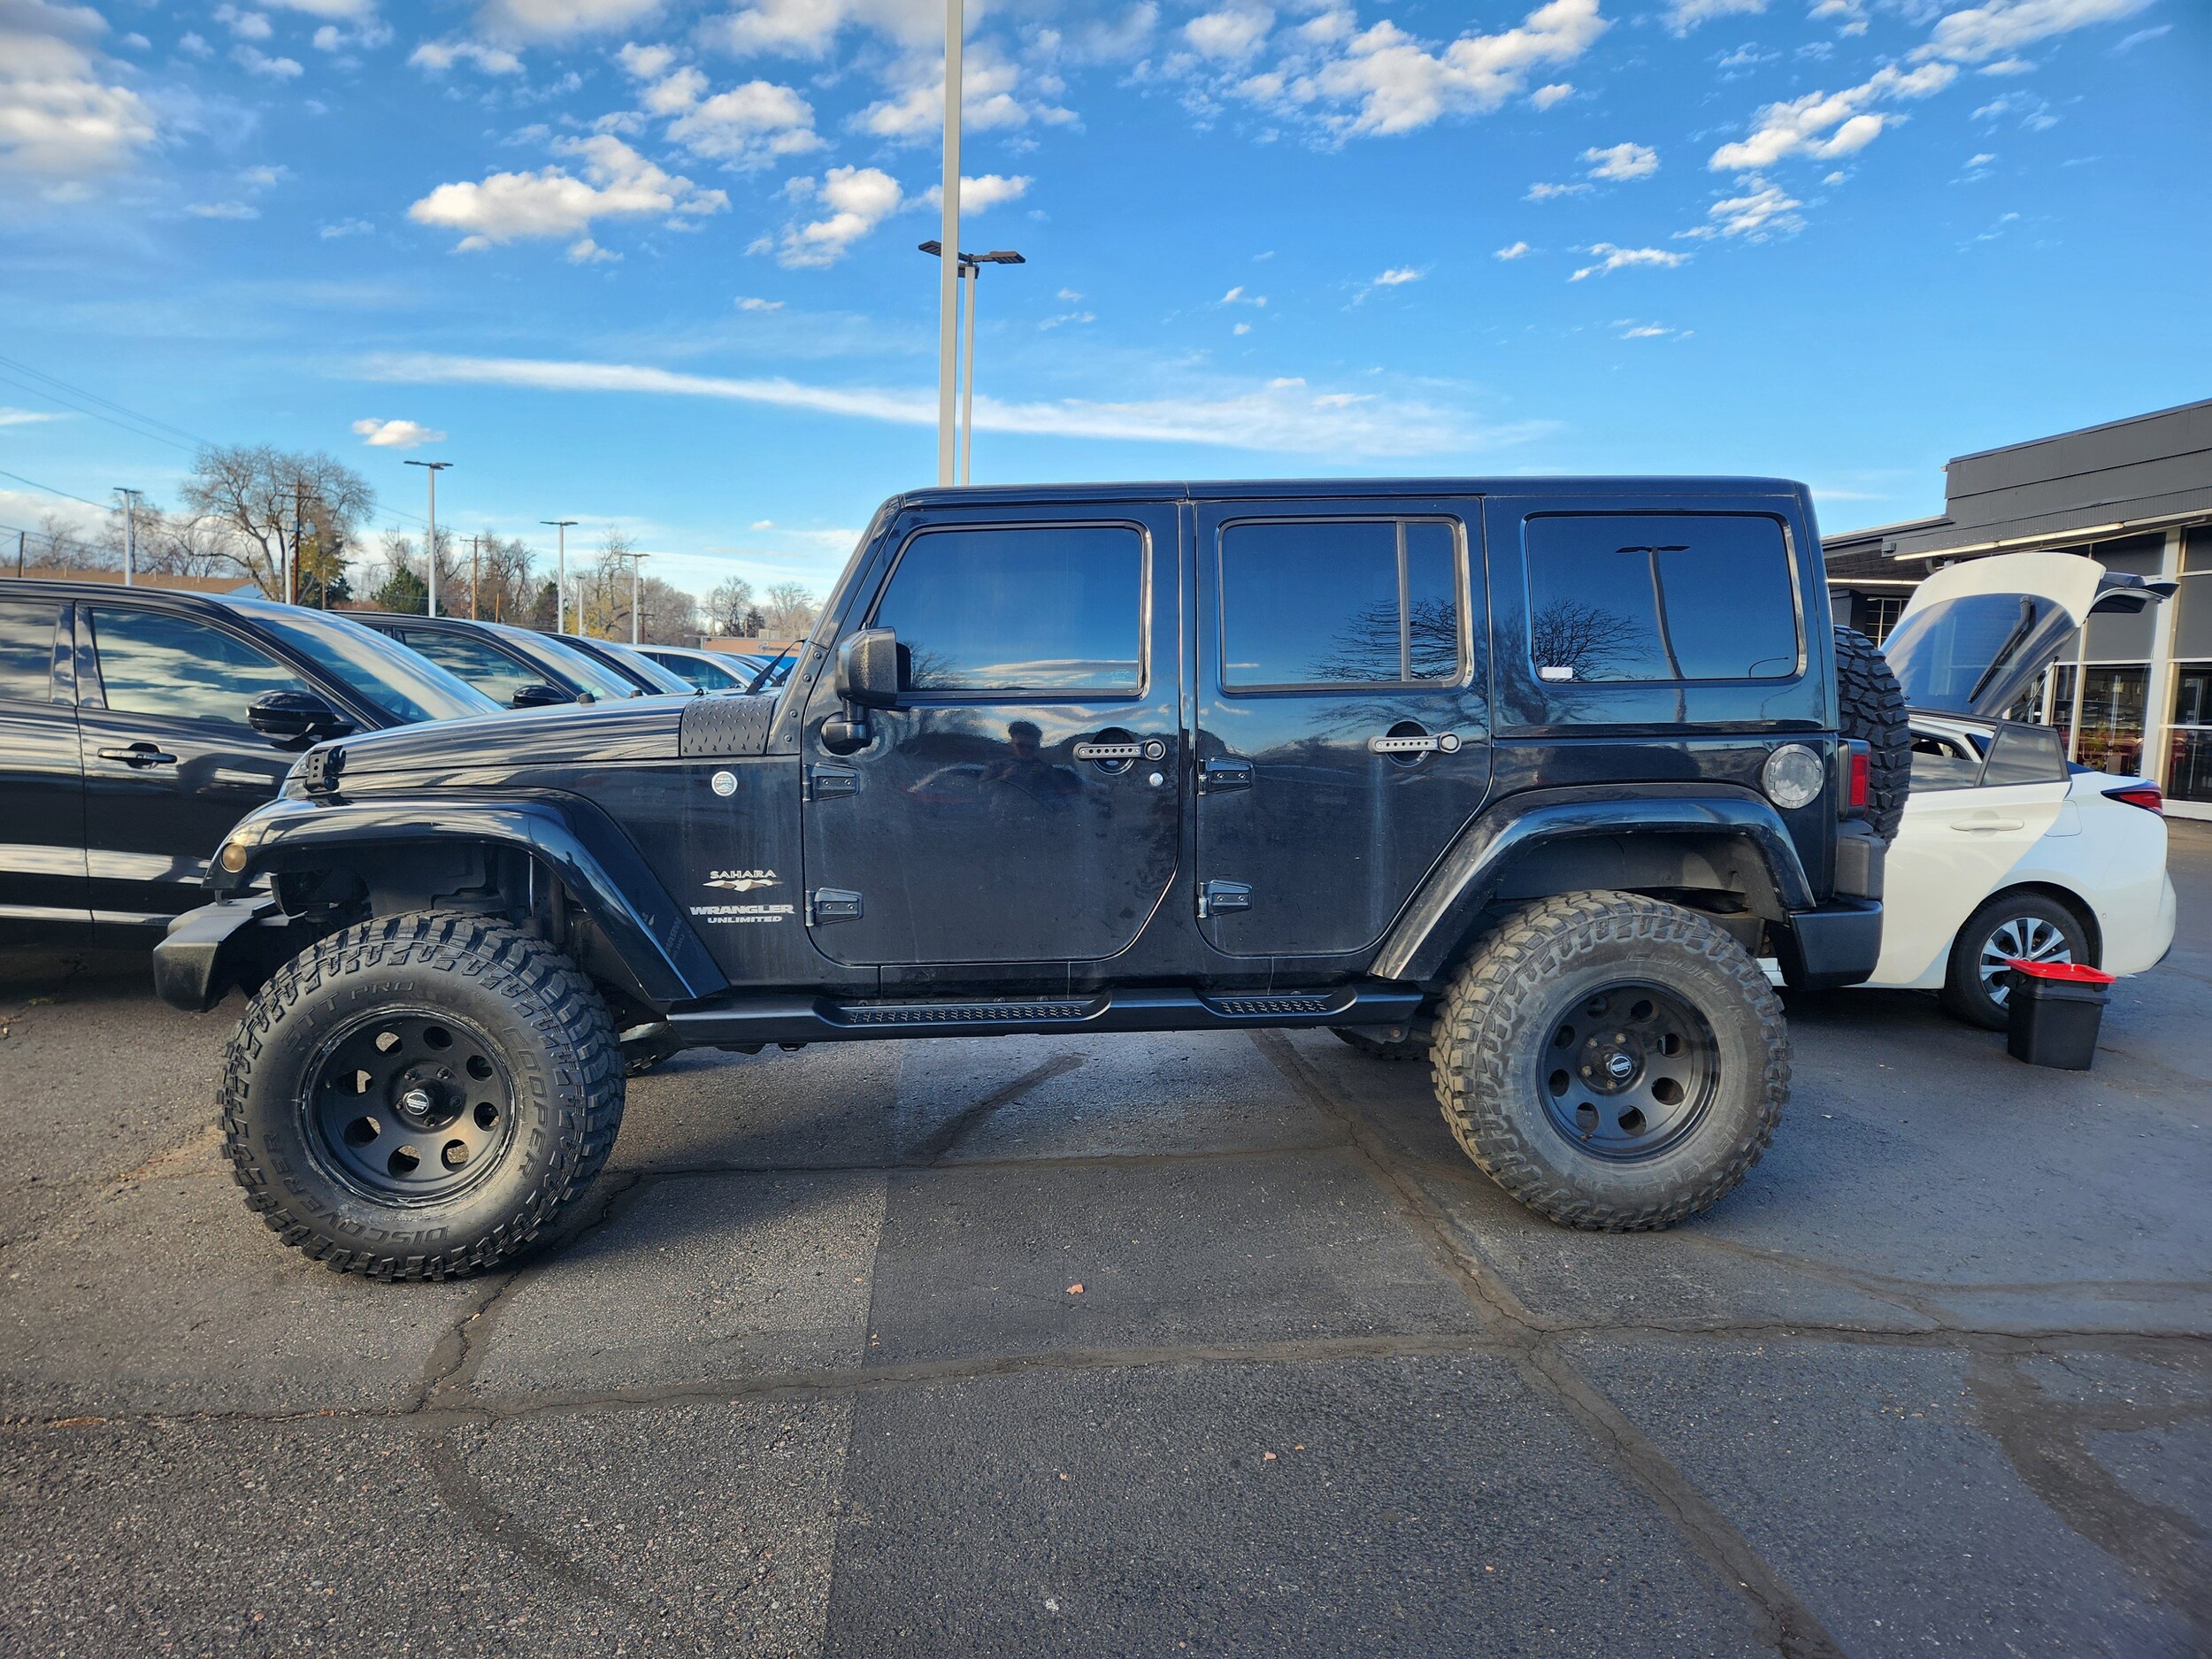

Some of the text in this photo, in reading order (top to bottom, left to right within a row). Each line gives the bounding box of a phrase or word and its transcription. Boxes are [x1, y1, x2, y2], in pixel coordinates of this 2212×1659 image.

[689, 904, 795, 916] WRANGLER
[710, 870, 777, 879] SAHARA
[280, 991, 340, 1054] STT
[350, 979, 416, 1001] PRO
[502, 1027, 549, 1179] COOPER
[263, 1131, 449, 1246] DISCOVERER
